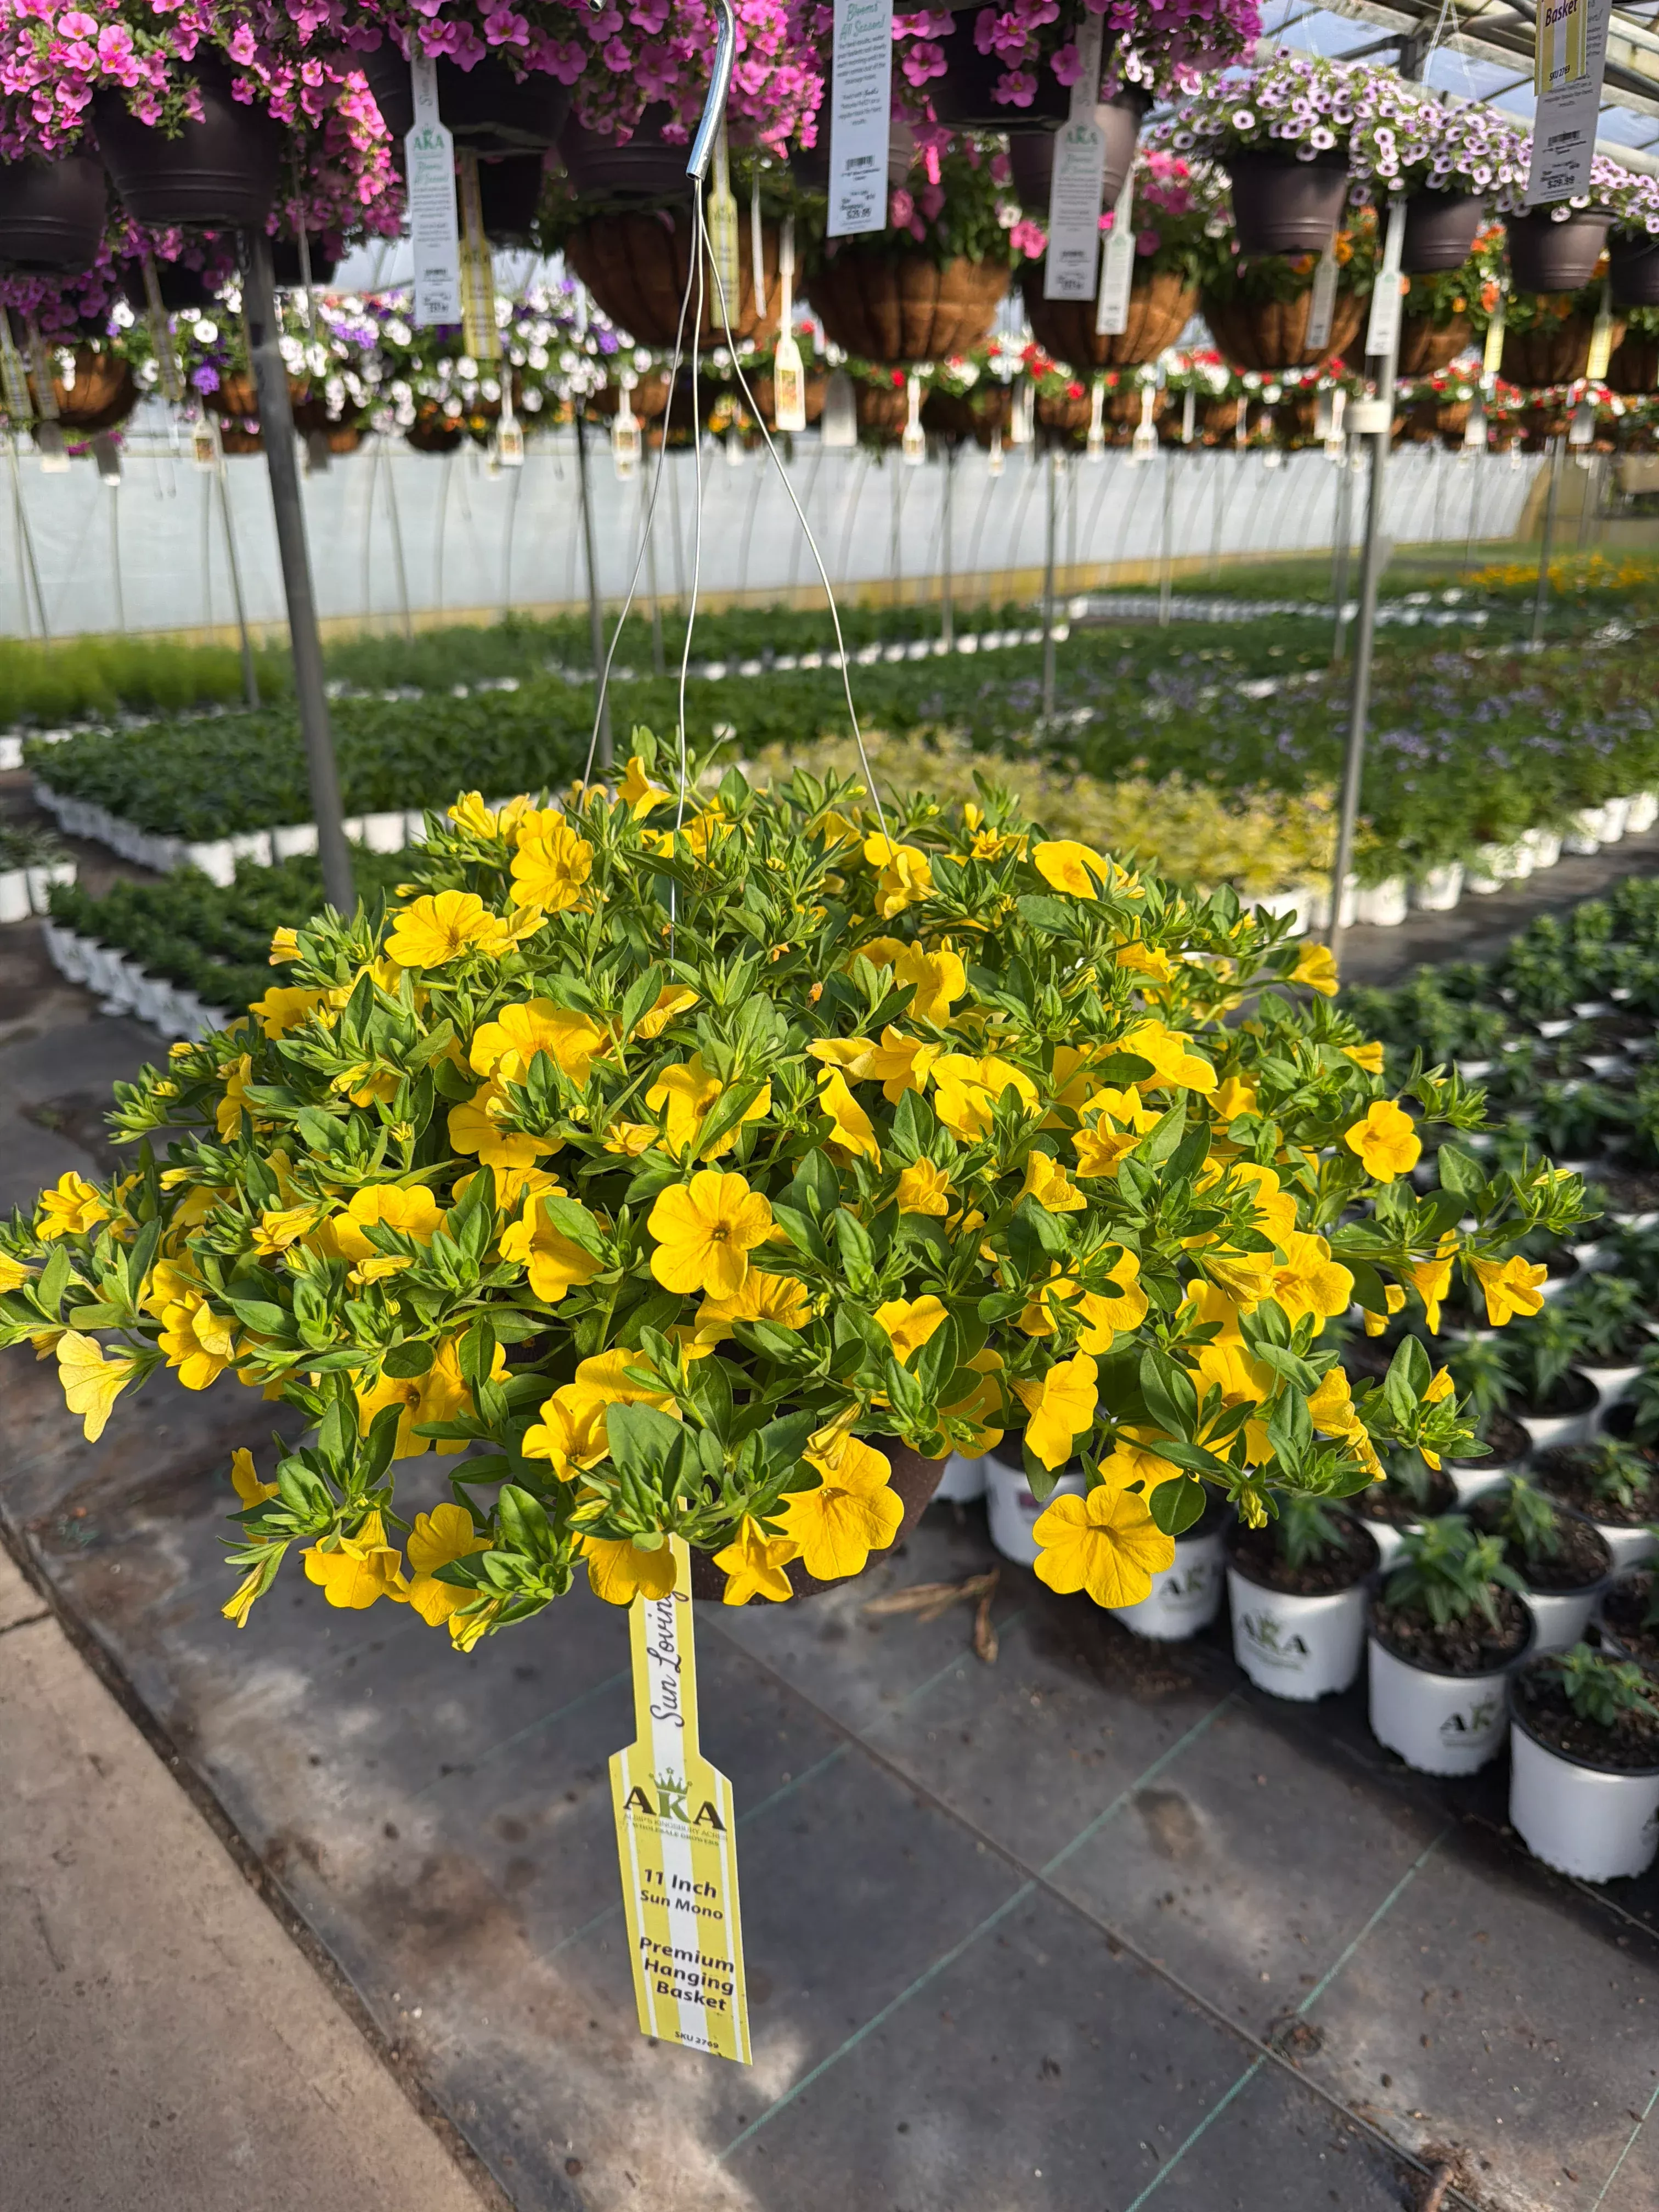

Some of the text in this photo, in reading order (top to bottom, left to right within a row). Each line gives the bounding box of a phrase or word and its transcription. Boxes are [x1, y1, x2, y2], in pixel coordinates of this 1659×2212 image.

[1545, 0, 1578, 27] Basket
[1549, 70, 1558, 82] SKU
[650, 1674, 685, 1728] Sun
[623, 1785, 727, 1832] AKA
[645, 1868, 717, 1898] 11 Inch
[640, 1889, 723, 1920] Sun Mono
[640, 1936, 734, 1973] Premium
[645, 1957, 733, 1996] Hanging
[656, 1980, 726, 2011] Basket
[675, 2031, 719, 2049] SKU 2769
